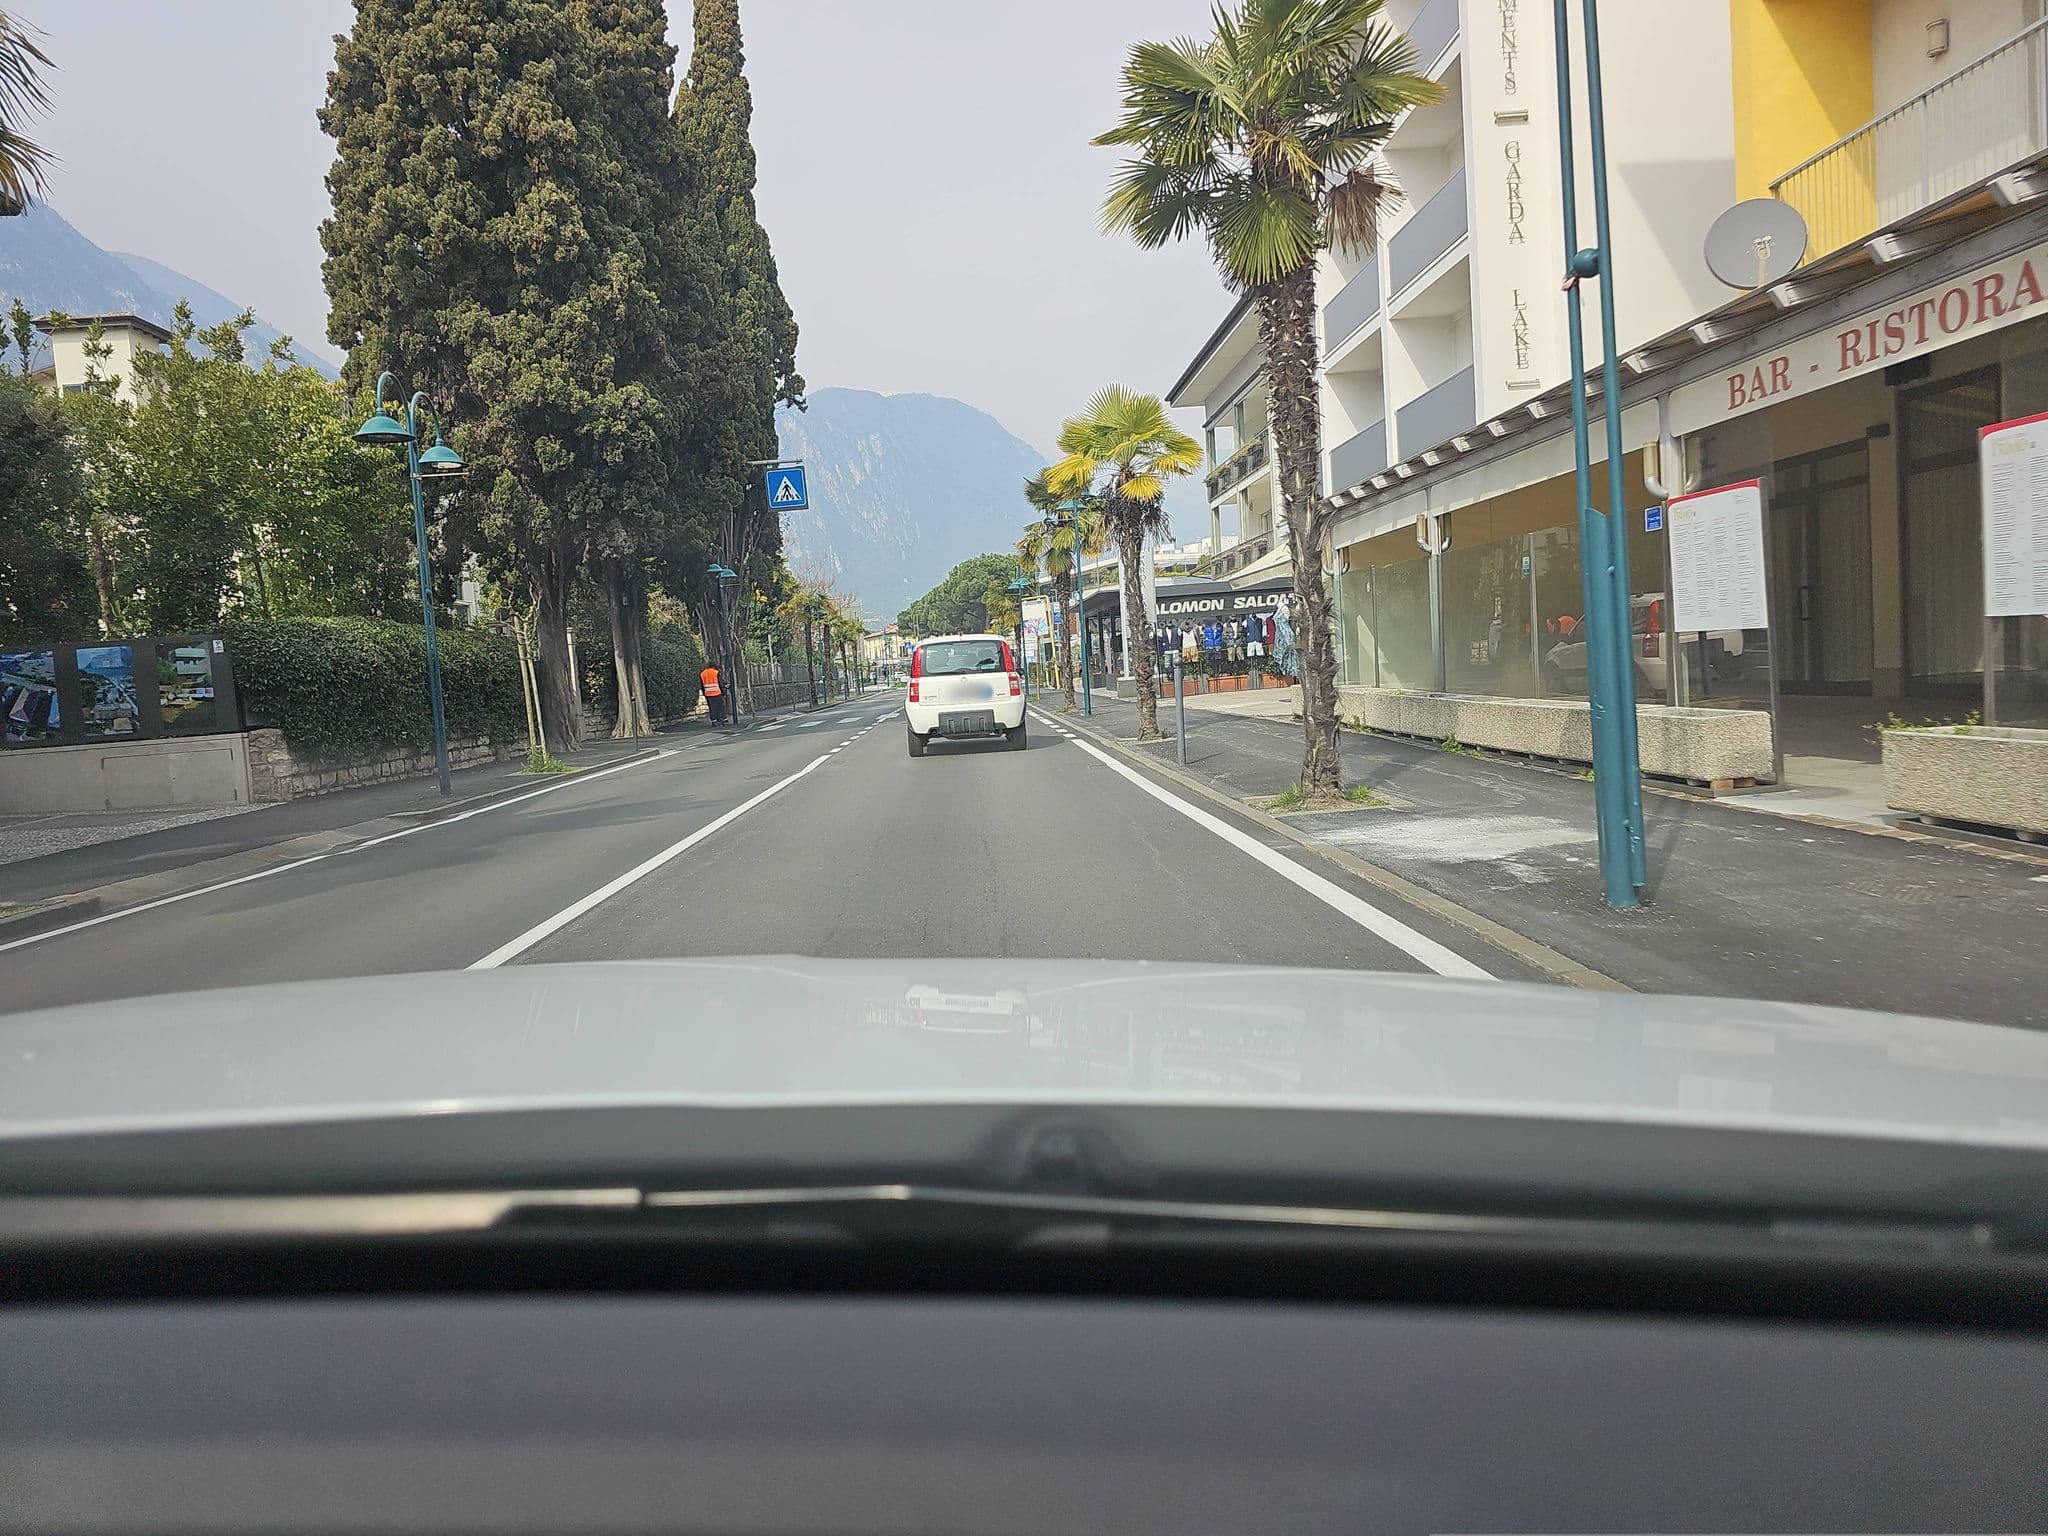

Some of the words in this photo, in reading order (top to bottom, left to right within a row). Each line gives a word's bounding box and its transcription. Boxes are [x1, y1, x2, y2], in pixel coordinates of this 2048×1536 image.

[1504, 141, 1525, 244] GARDA
[1512, 289, 1530, 369] LAKE
[1727, 356, 1792, 410] BAR
[1836, 259, 2045, 373] RISTORA
